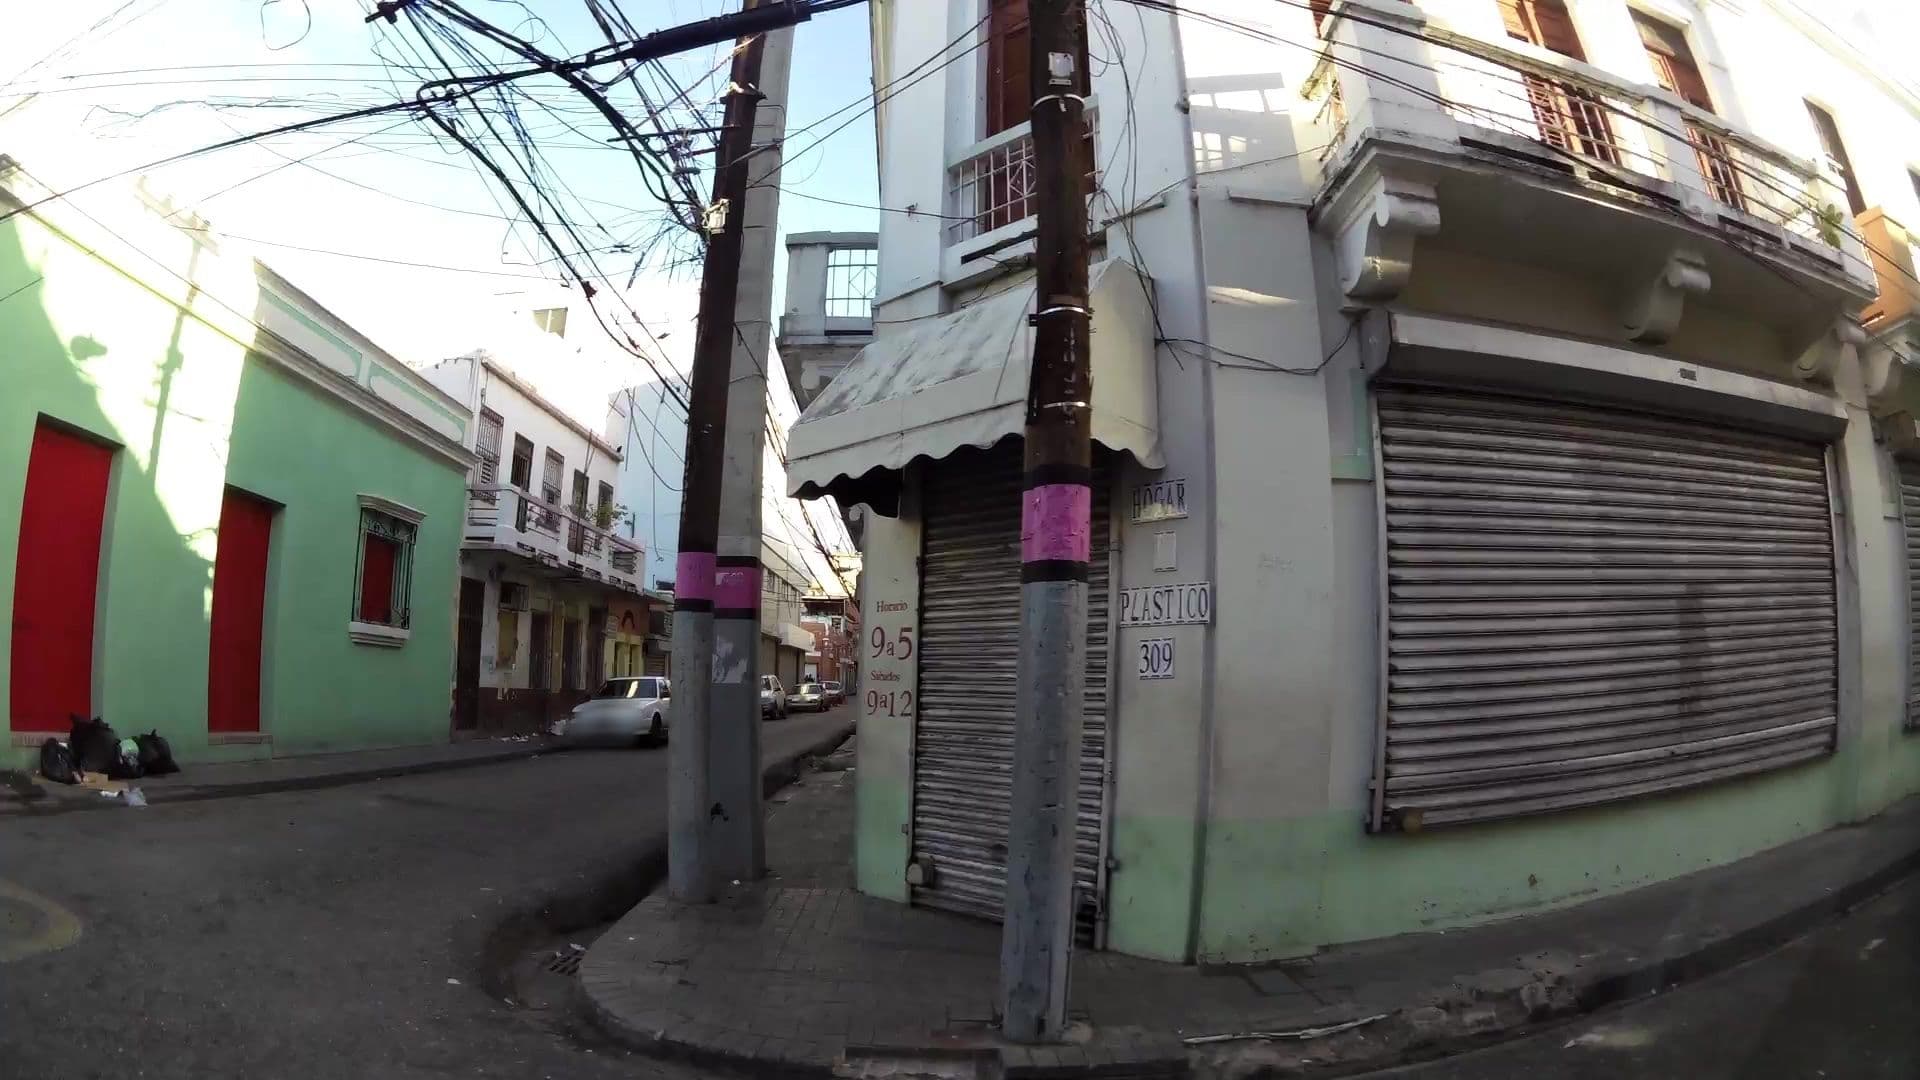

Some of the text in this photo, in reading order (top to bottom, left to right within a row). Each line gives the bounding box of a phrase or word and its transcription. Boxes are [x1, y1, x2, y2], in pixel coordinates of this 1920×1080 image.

[1132, 484, 1186, 519] HOGAR
[877, 601, 908, 613] Horario
[1120, 588, 1209, 622] PLASTICO
[1139, 643, 1173, 674] 309
